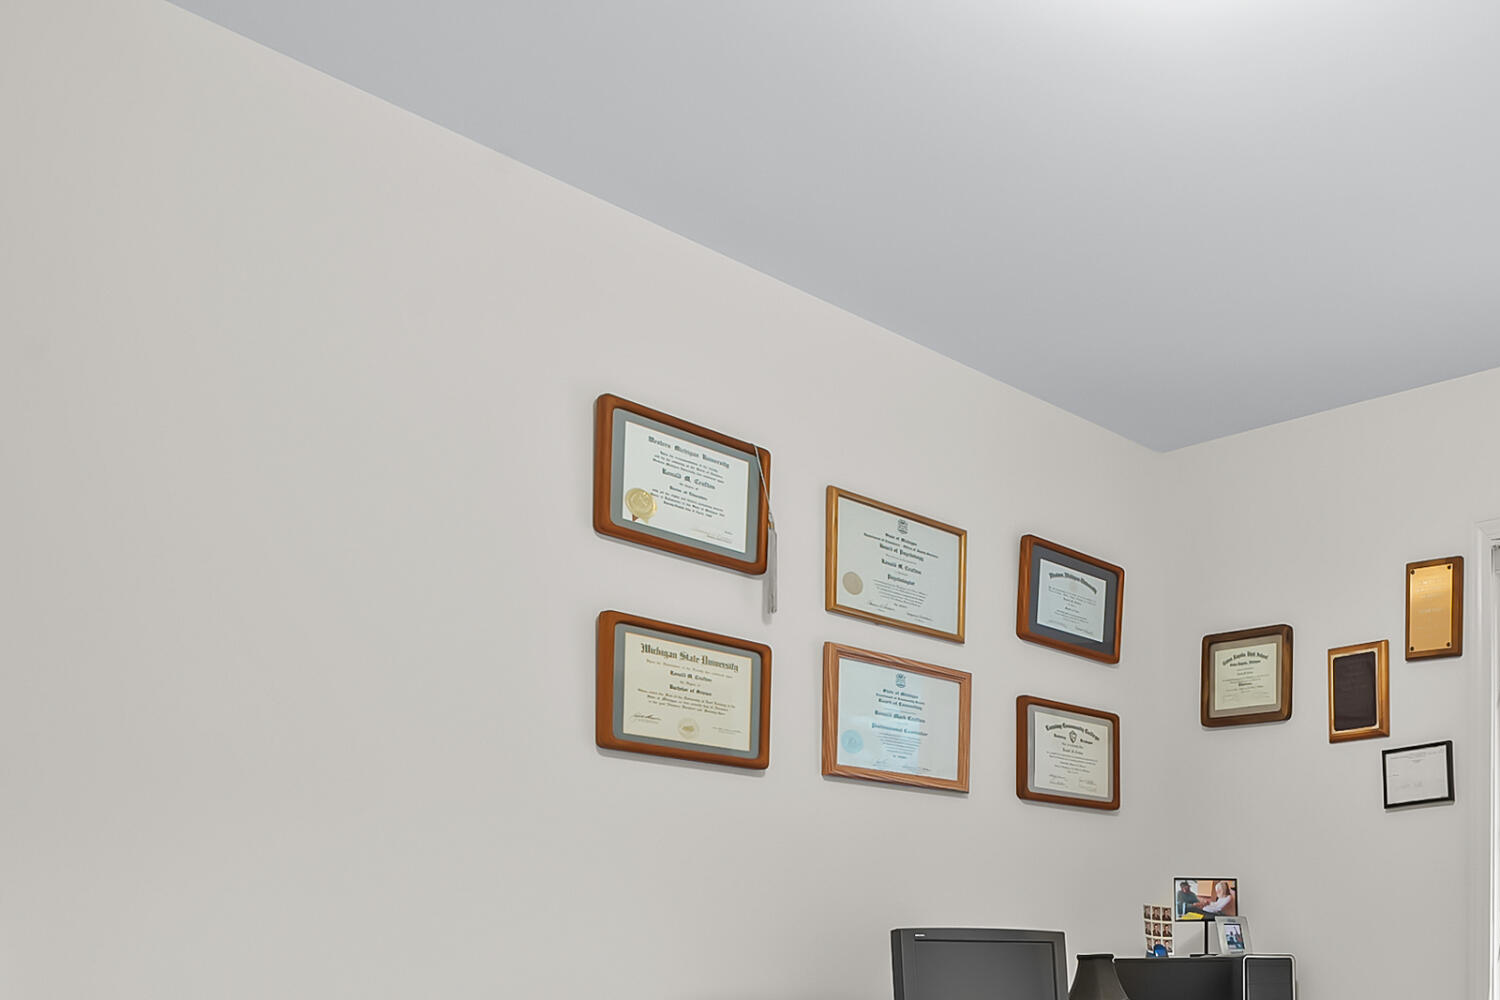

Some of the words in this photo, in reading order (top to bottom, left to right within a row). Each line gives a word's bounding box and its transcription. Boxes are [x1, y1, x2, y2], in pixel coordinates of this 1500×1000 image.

[641, 642, 678, 660] Michigan
[679, 650, 700, 664] State
[701, 655, 739, 673] University
